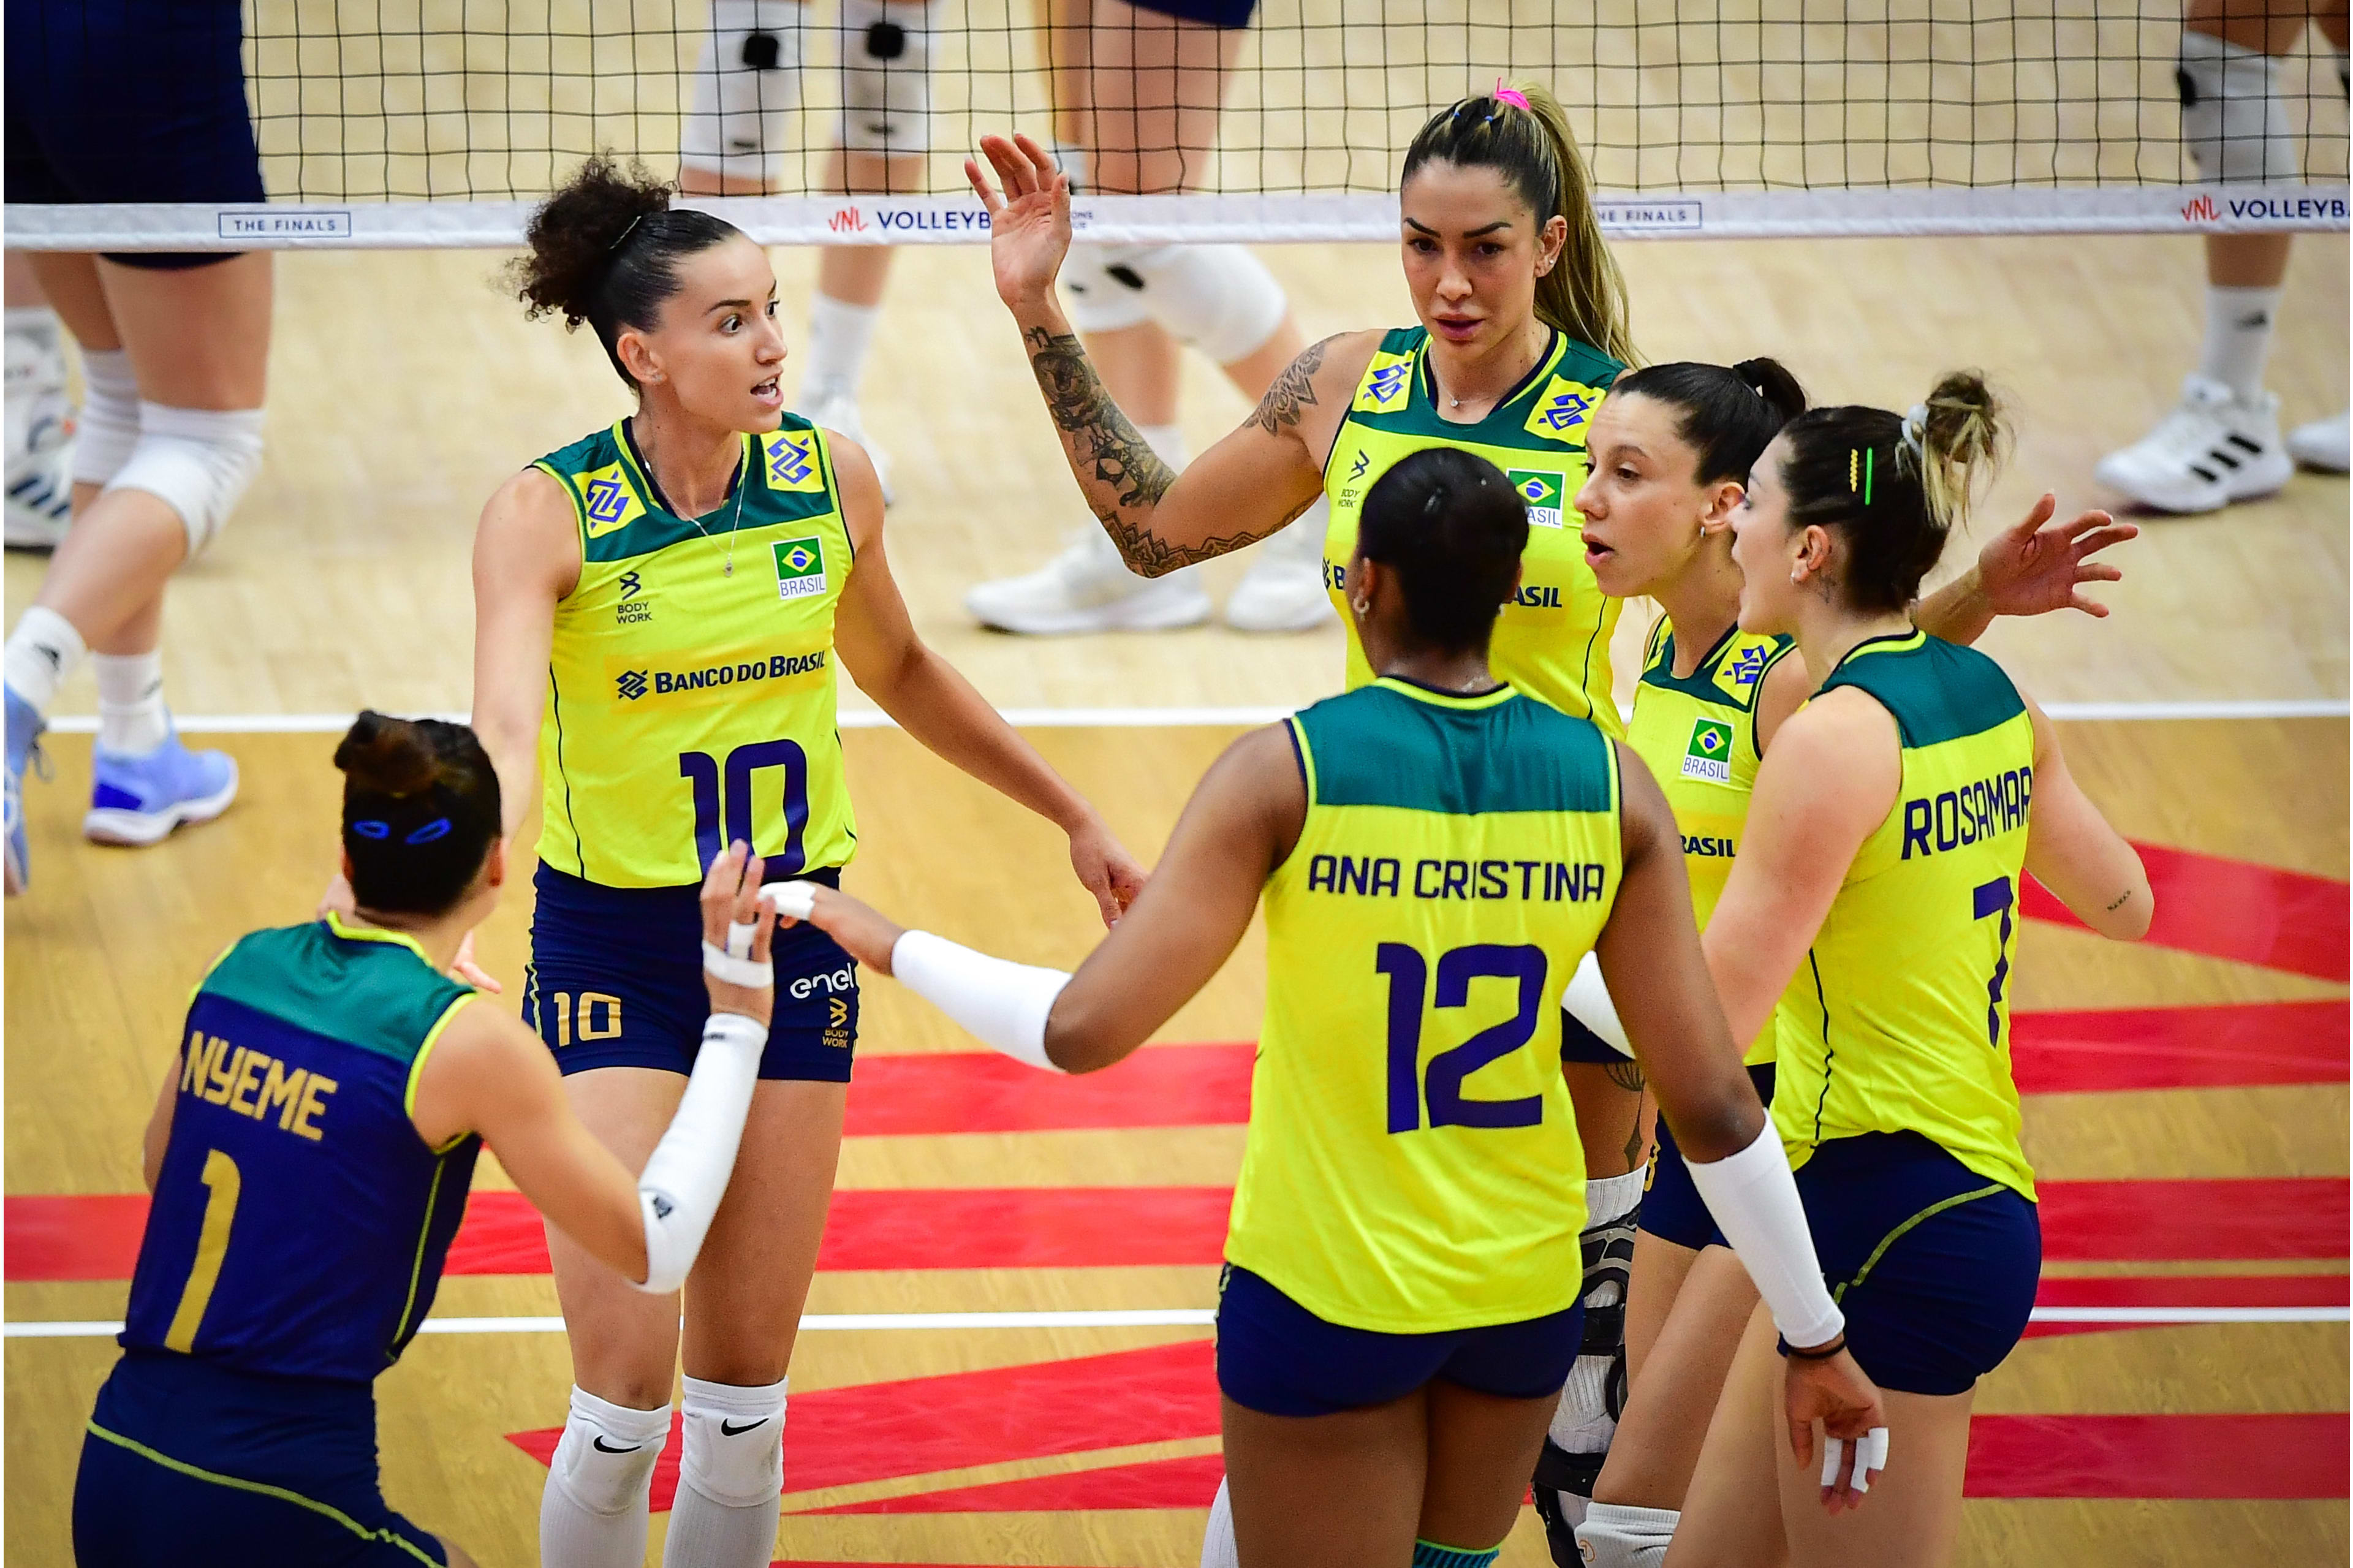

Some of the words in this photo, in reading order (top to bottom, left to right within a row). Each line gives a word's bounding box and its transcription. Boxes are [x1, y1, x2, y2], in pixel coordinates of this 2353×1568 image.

[1597, 210, 1615, 222] HE
[1626, 210, 1687, 222] FINALS
[2229, 199, 2350, 218] VOLLEYB
[235, 220, 265, 231] THE
[275, 219, 336, 231] FINALS
[877, 211, 991, 230] VOLLEYB
[1528, 509, 1561, 526] ASIL
[780, 576, 825, 597] BRASIL
[1516, 586, 1563, 608] ASIL
[616, 612, 652, 624] WORK
[618, 602, 650, 613] BODY
[655, 666, 733, 694] BANCO
[737, 661, 767, 683] DO
[769, 650, 825, 678] BRASIL
[1683, 757, 1729, 779] BRASIL
[680, 739, 808, 881] 10
[1901, 766, 2032, 860] ROSAMAR
[1308, 854, 1401, 897] ANA
[1414, 859, 1605, 903] CRISTINA
[1973, 876, 2014, 1048] 7
[790, 962, 855, 999] enel
[553, 991, 622, 1047] 10
[822, 1036, 848, 1048] WORK
[825, 1028, 849, 1037] BODY
[1376, 942, 1548, 1134] 12
[181, 1030, 338, 1142] NYEME
[164, 1148, 241, 1354] 1
